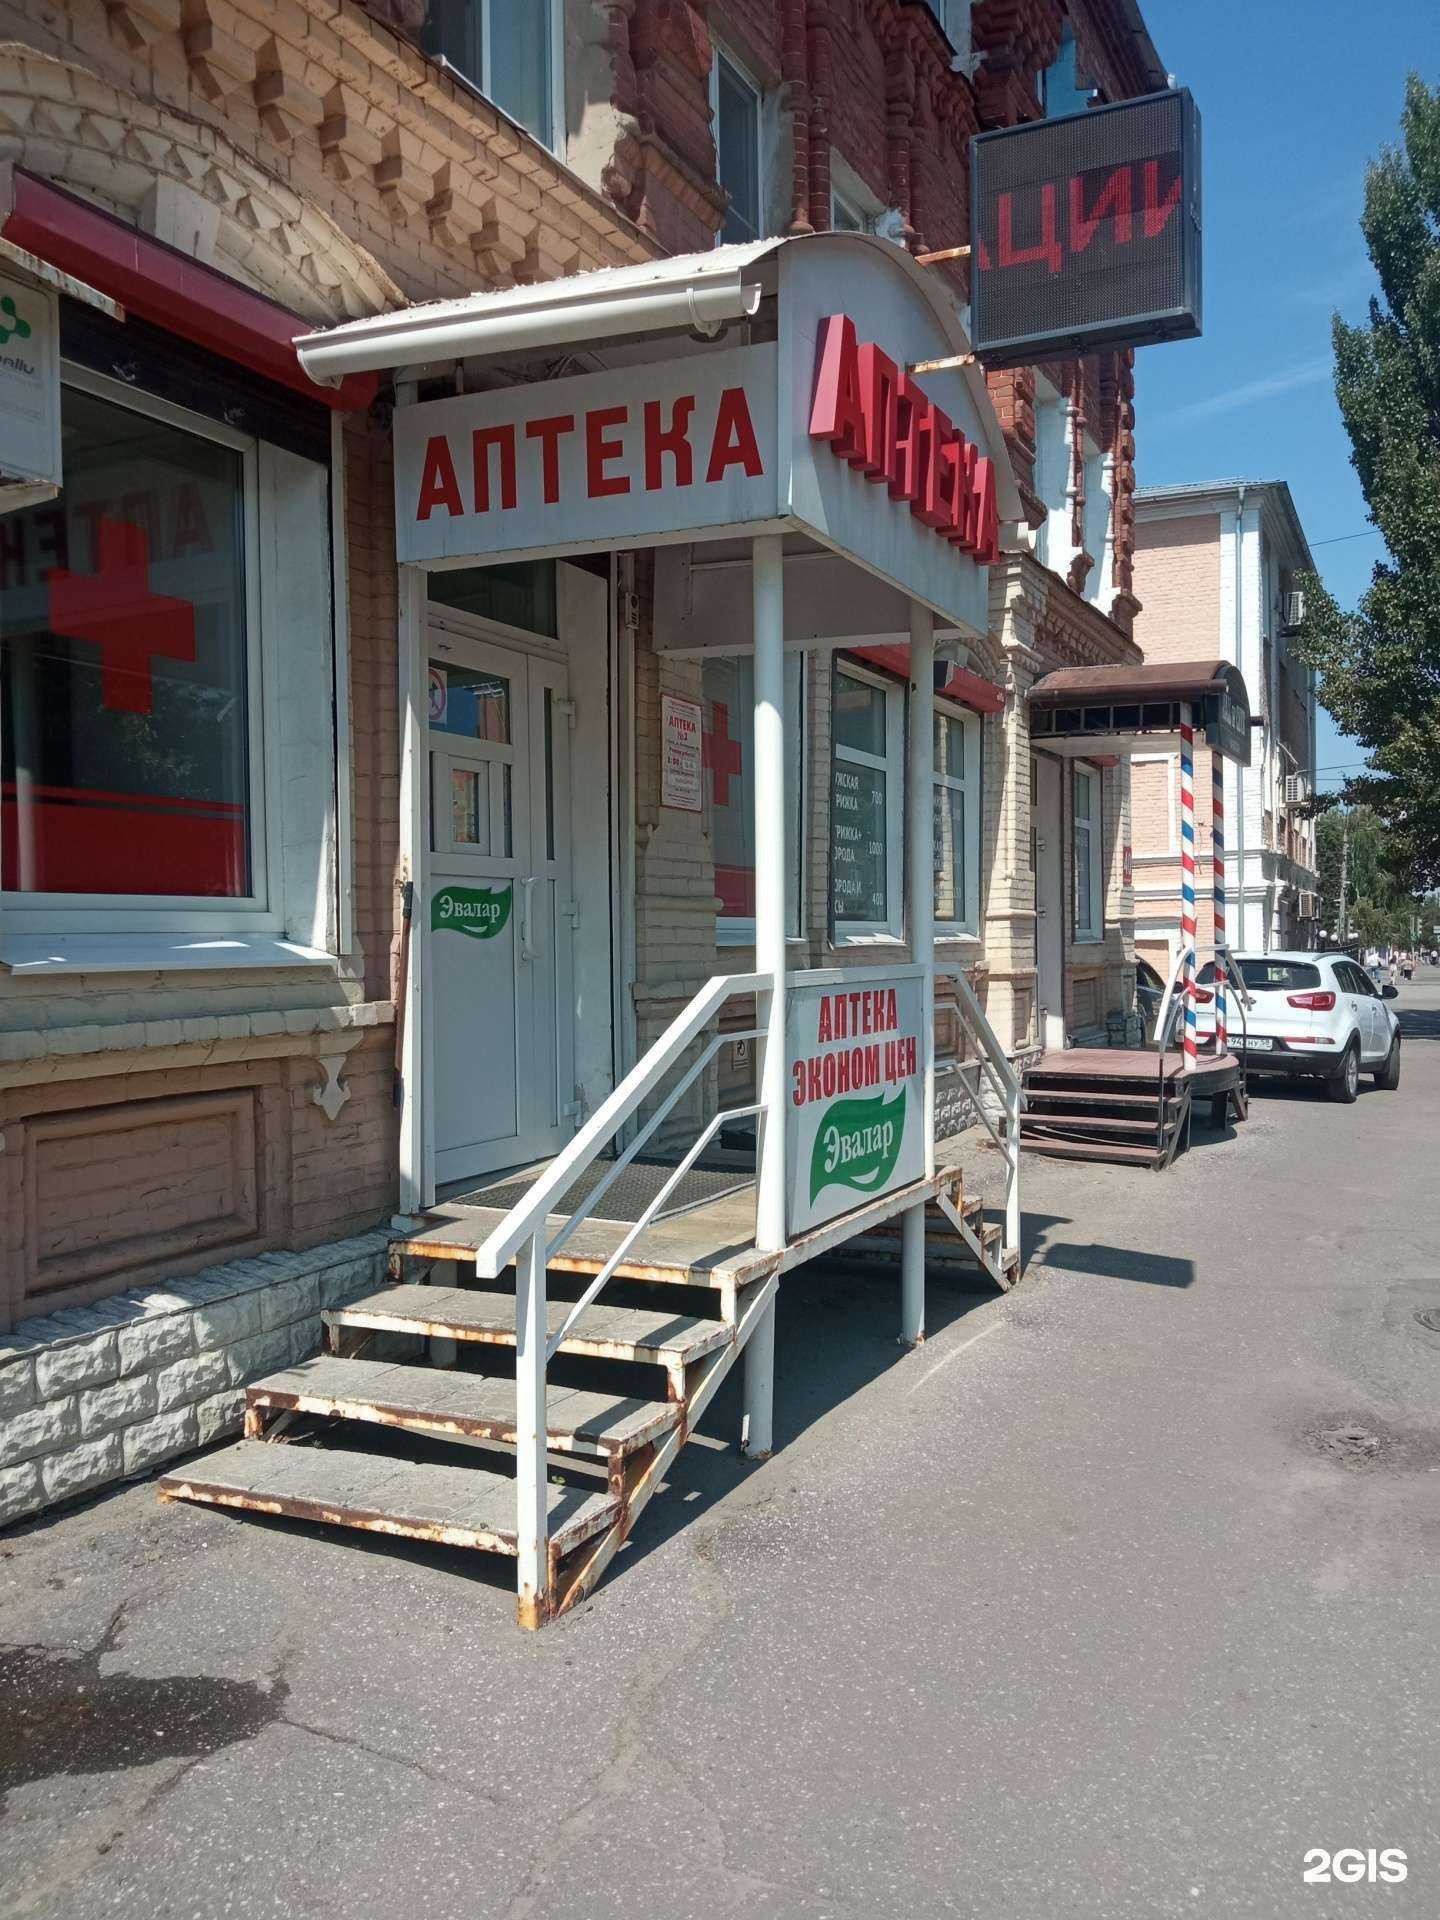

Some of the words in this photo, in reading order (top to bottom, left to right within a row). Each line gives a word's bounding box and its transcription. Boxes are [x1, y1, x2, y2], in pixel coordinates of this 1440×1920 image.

[416, 386, 764, 521] АПТЕКА
[669, 715, 697, 734] АПТЕКА
[439, 894, 501, 920] Эвалар
[818, 988, 898, 1044] АПТЕКА
[791, 1043, 881, 1107] ЭКОНОМ
[884, 1036, 917, 1087] ЦЕН
[823, 1119, 895, 1174] Эвалар
